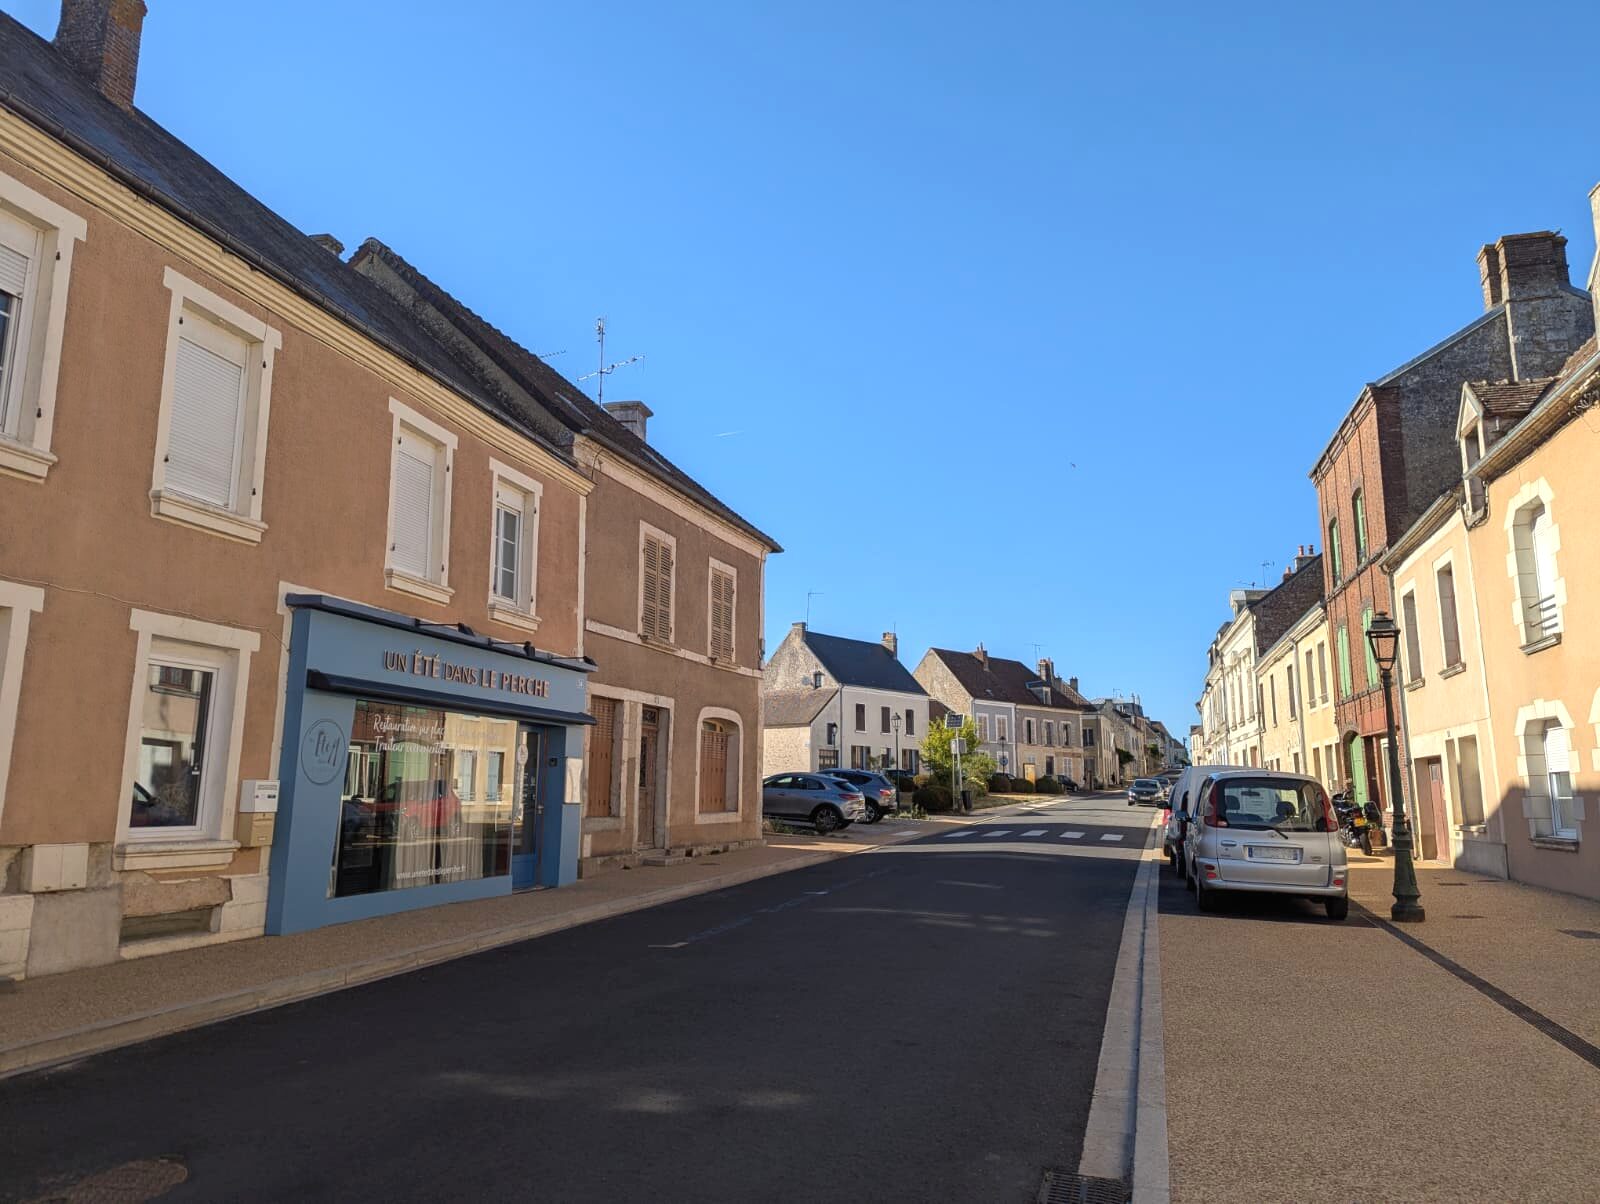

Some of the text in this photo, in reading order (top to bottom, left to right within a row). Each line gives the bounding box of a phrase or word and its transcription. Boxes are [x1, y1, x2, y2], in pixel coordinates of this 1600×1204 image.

[384, 650, 407, 672] UN
[412, 648, 441, 679] ÉTÉ
[444, 661, 478, 685] DANS
[481, 667, 498, 689] LE
[500, 672, 550, 698] PERCHE
